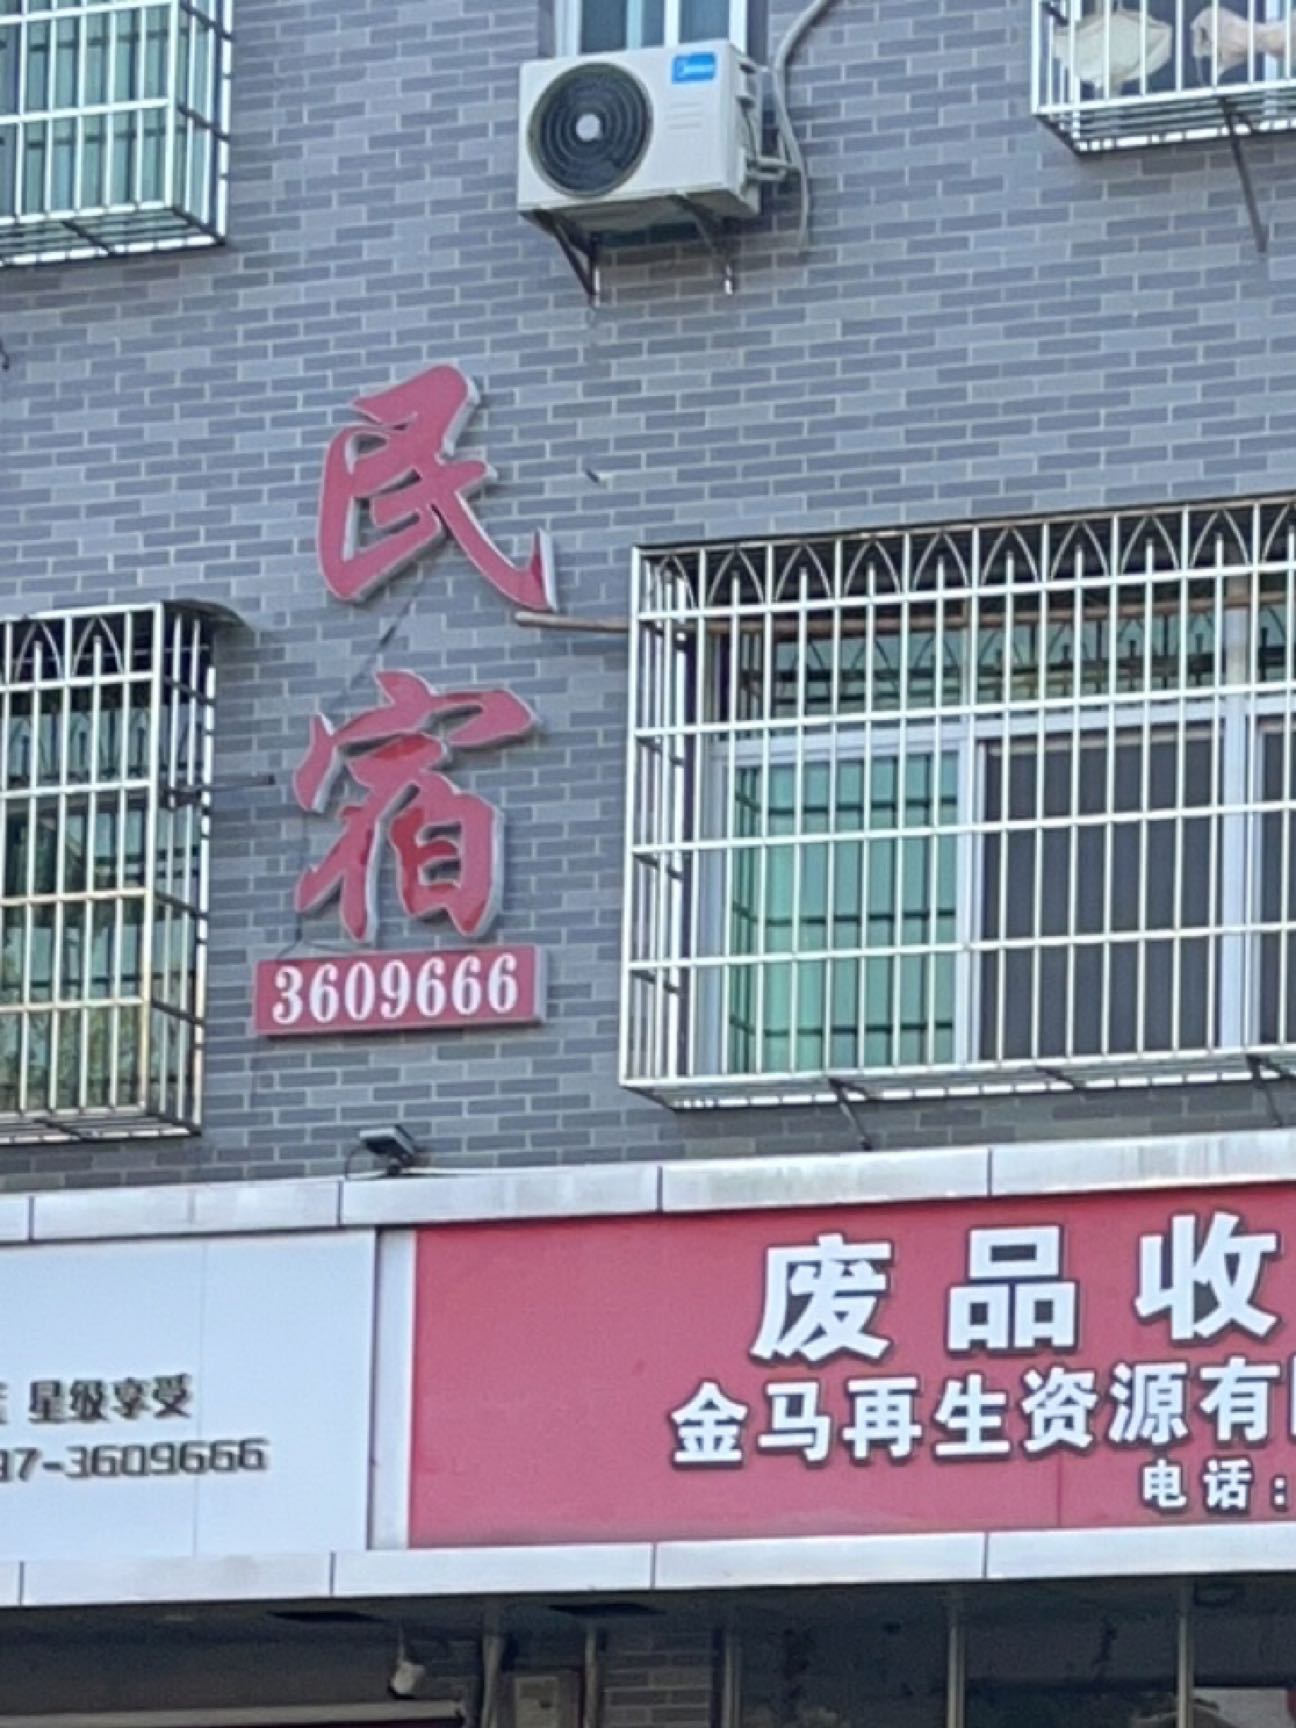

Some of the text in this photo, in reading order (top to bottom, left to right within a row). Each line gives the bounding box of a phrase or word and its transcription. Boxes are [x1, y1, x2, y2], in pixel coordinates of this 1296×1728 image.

[294, 364, 558, 942] 民宿
[272, 953, 519, 1026] 3609666
[29, 1373, 192, 1425] 星级享受
